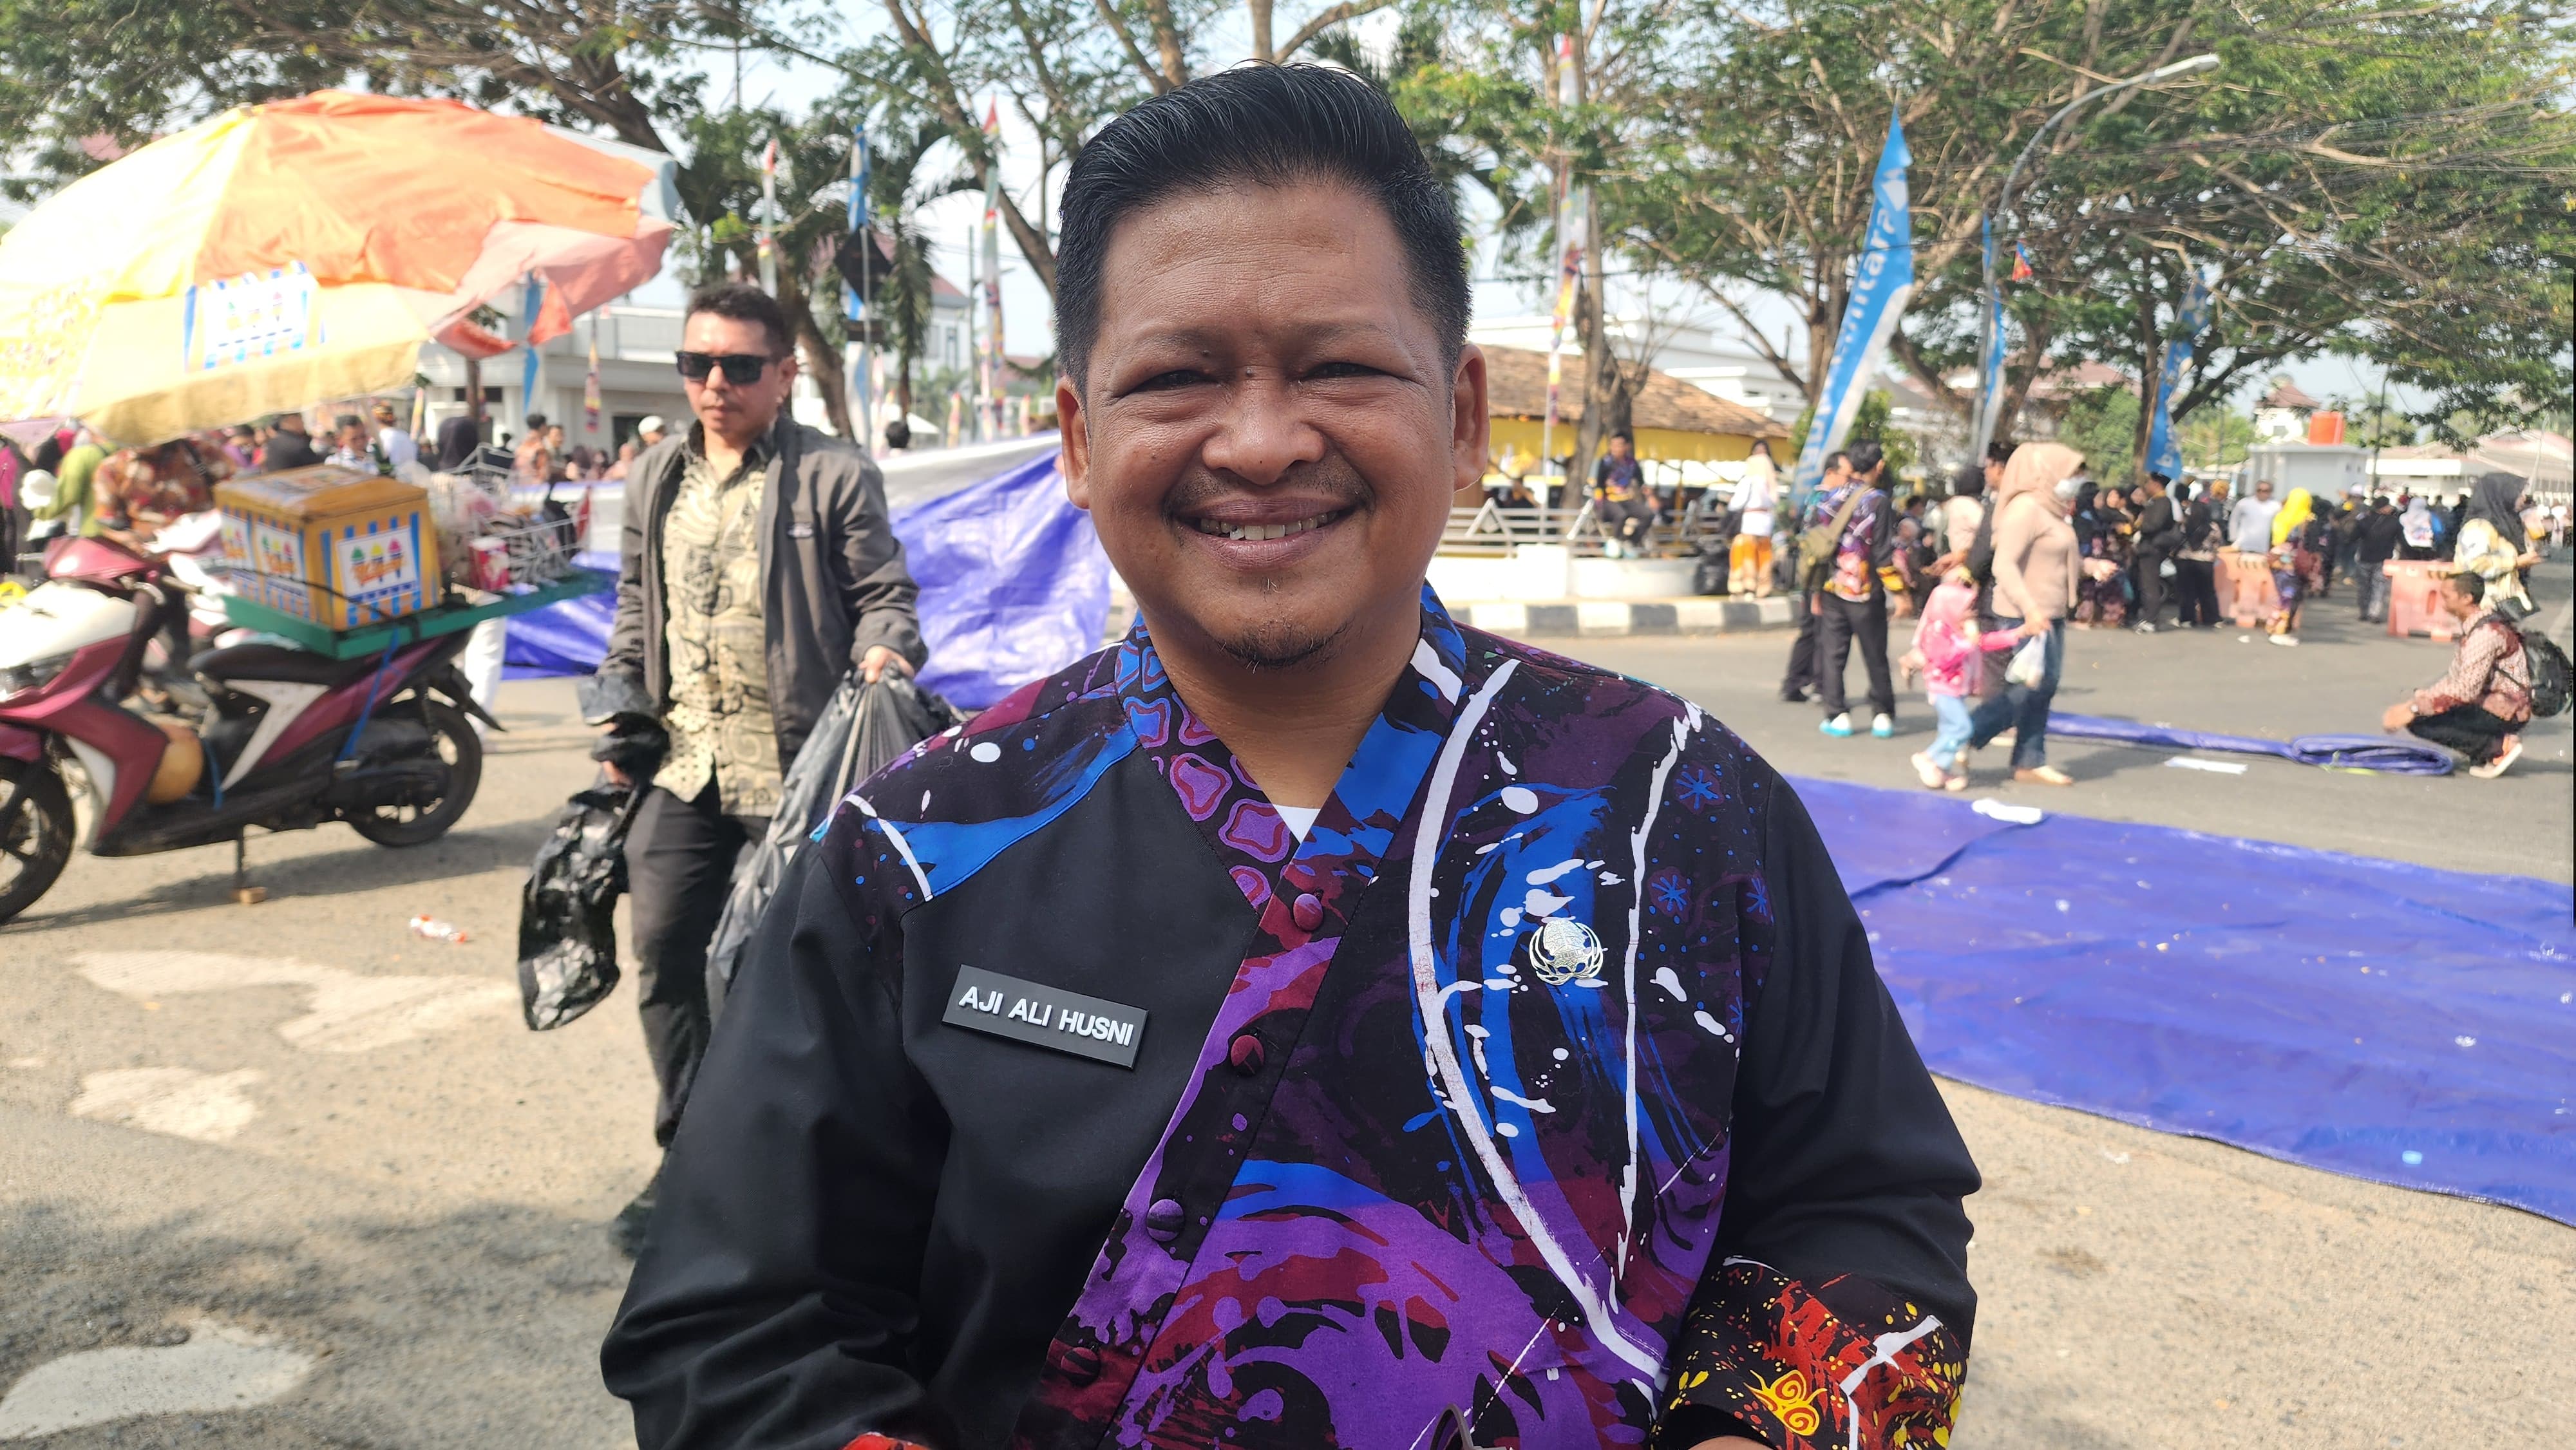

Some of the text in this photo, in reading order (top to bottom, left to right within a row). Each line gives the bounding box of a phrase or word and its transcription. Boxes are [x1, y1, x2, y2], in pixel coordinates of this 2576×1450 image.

[958, 986, 1134, 1046] AJI ALI HUSNI
